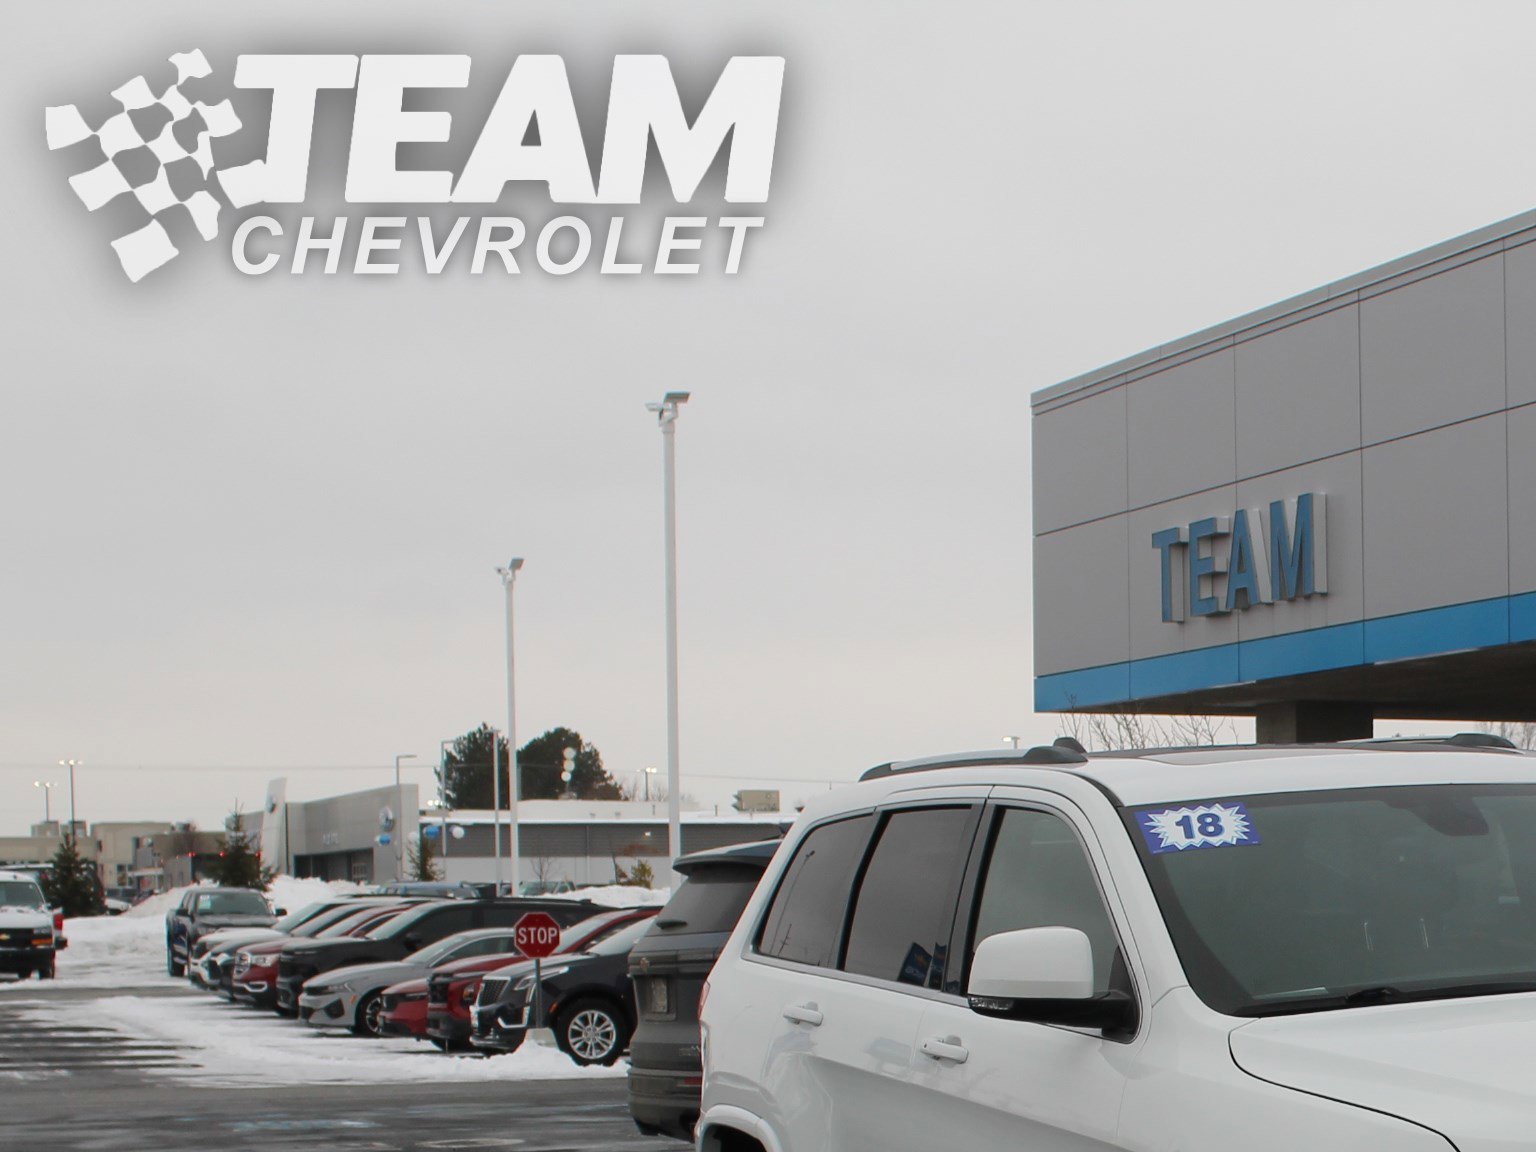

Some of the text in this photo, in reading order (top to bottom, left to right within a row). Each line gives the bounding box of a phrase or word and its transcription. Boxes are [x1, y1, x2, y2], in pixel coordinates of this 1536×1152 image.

[1151, 492, 1327, 623] TEAM
[1175, 813, 1224, 840] 18
[517, 926, 558, 945] STOP
